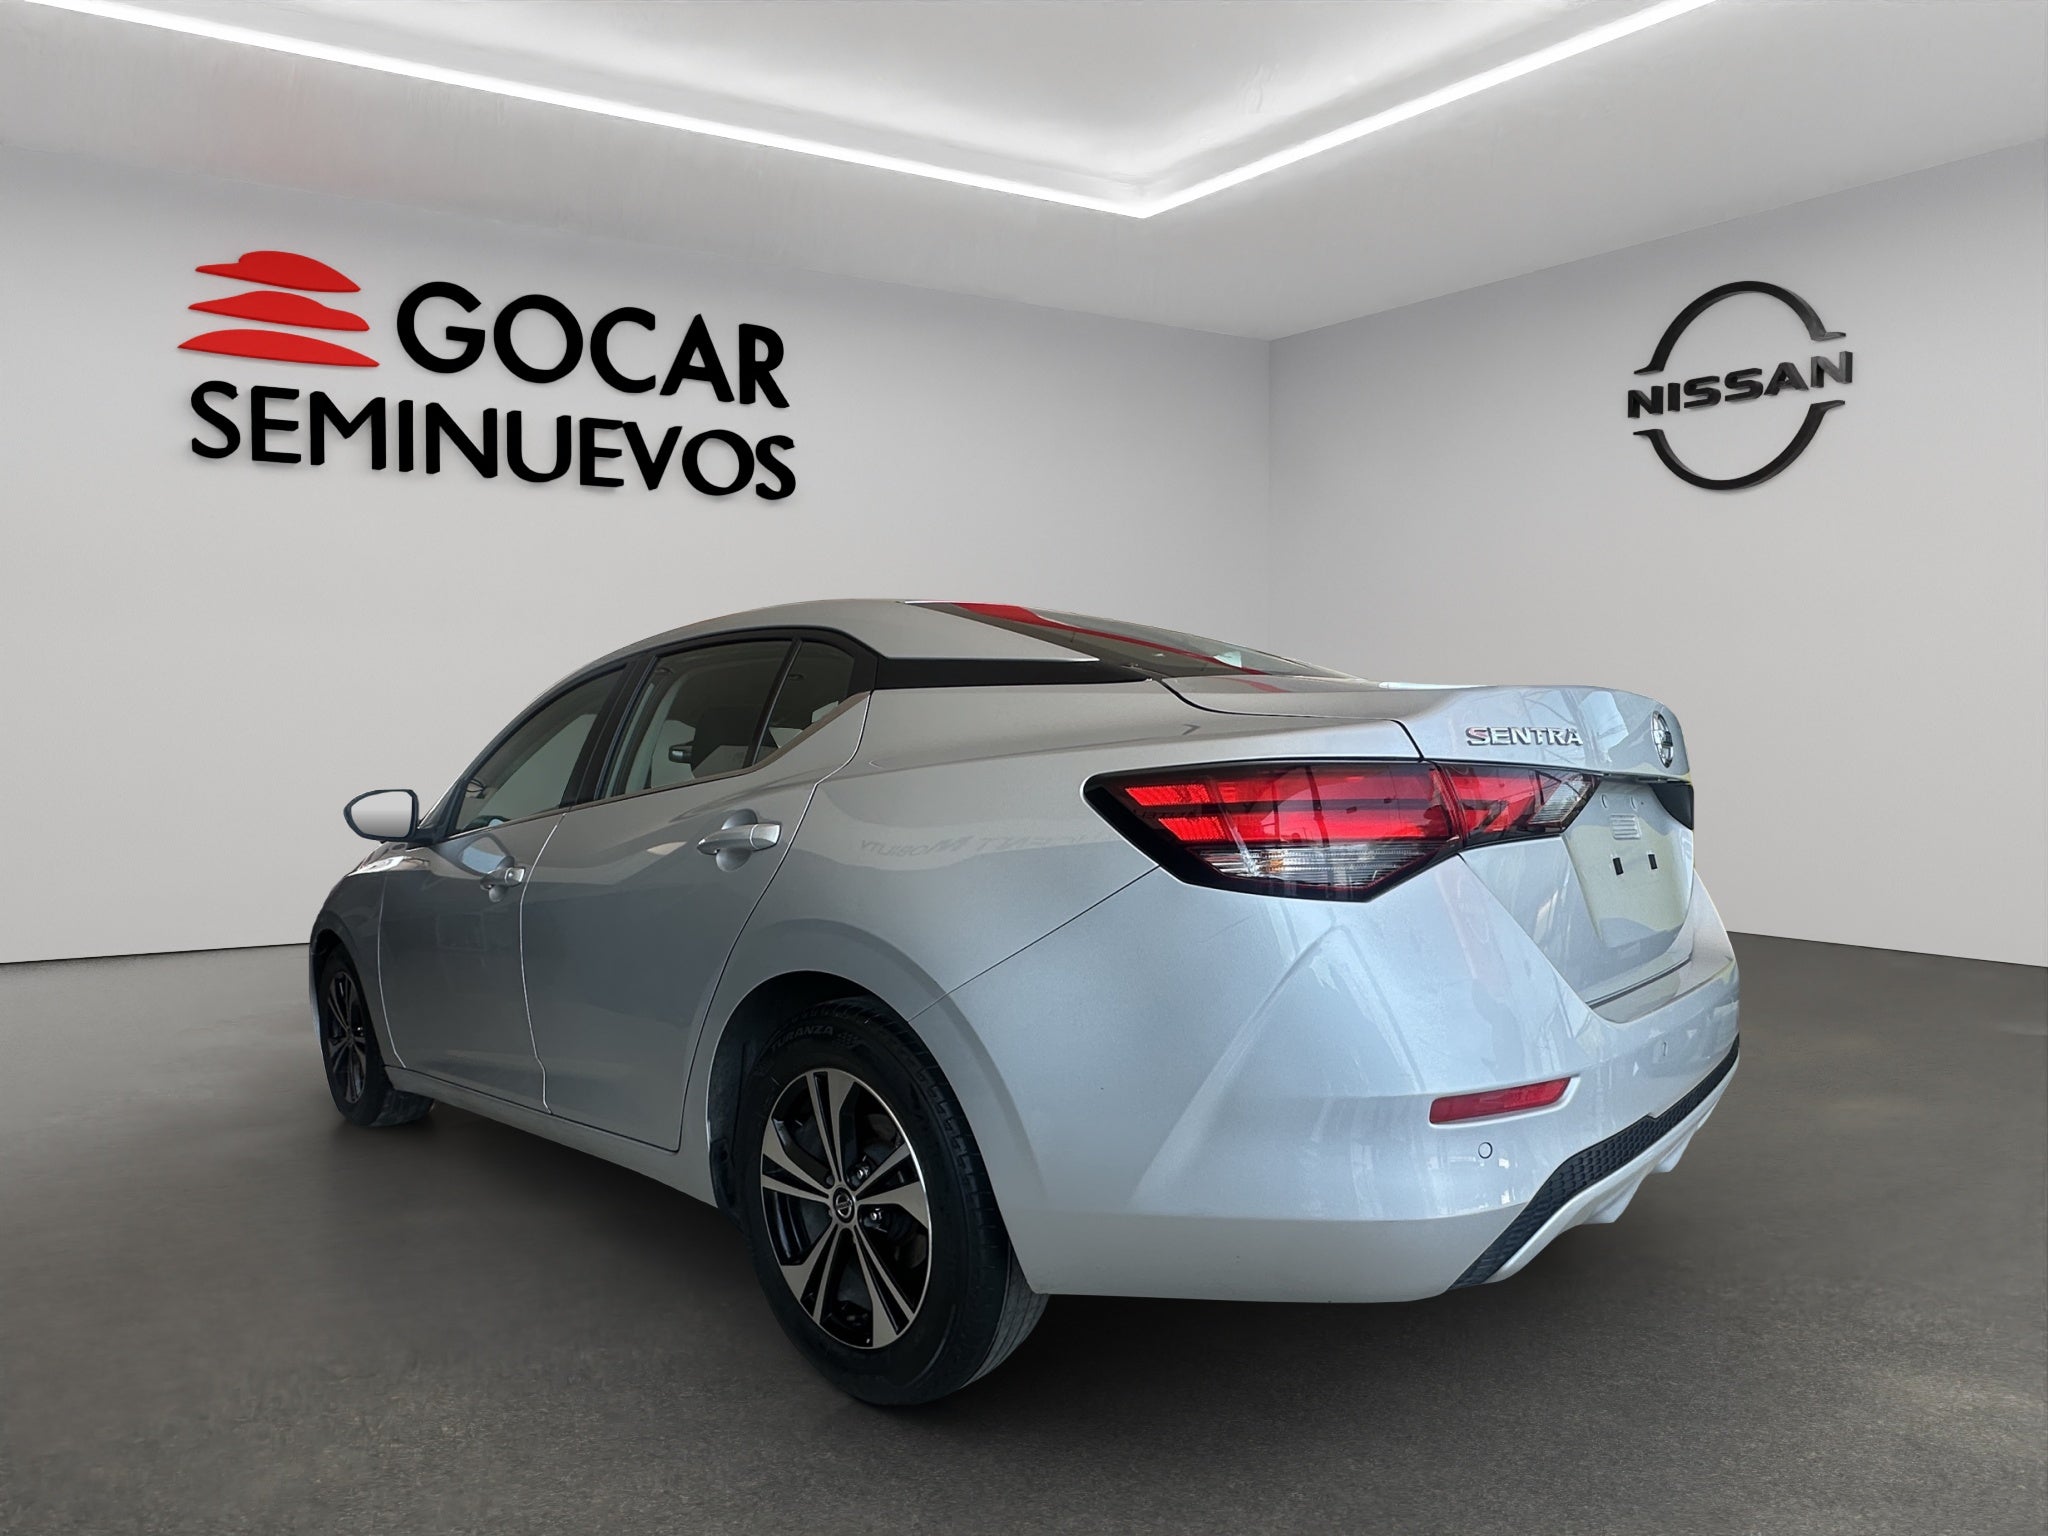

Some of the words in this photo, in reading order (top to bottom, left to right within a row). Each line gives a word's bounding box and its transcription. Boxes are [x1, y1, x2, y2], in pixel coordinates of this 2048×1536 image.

[396, 280, 790, 409] GOCAR
[1627, 350, 1854, 419] NISSAN
[190, 380, 797, 501] SEMINUEVOS
[1465, 726, 1584, 746] SENTRA
[770, 1024, 834, 1052] TURANZA
